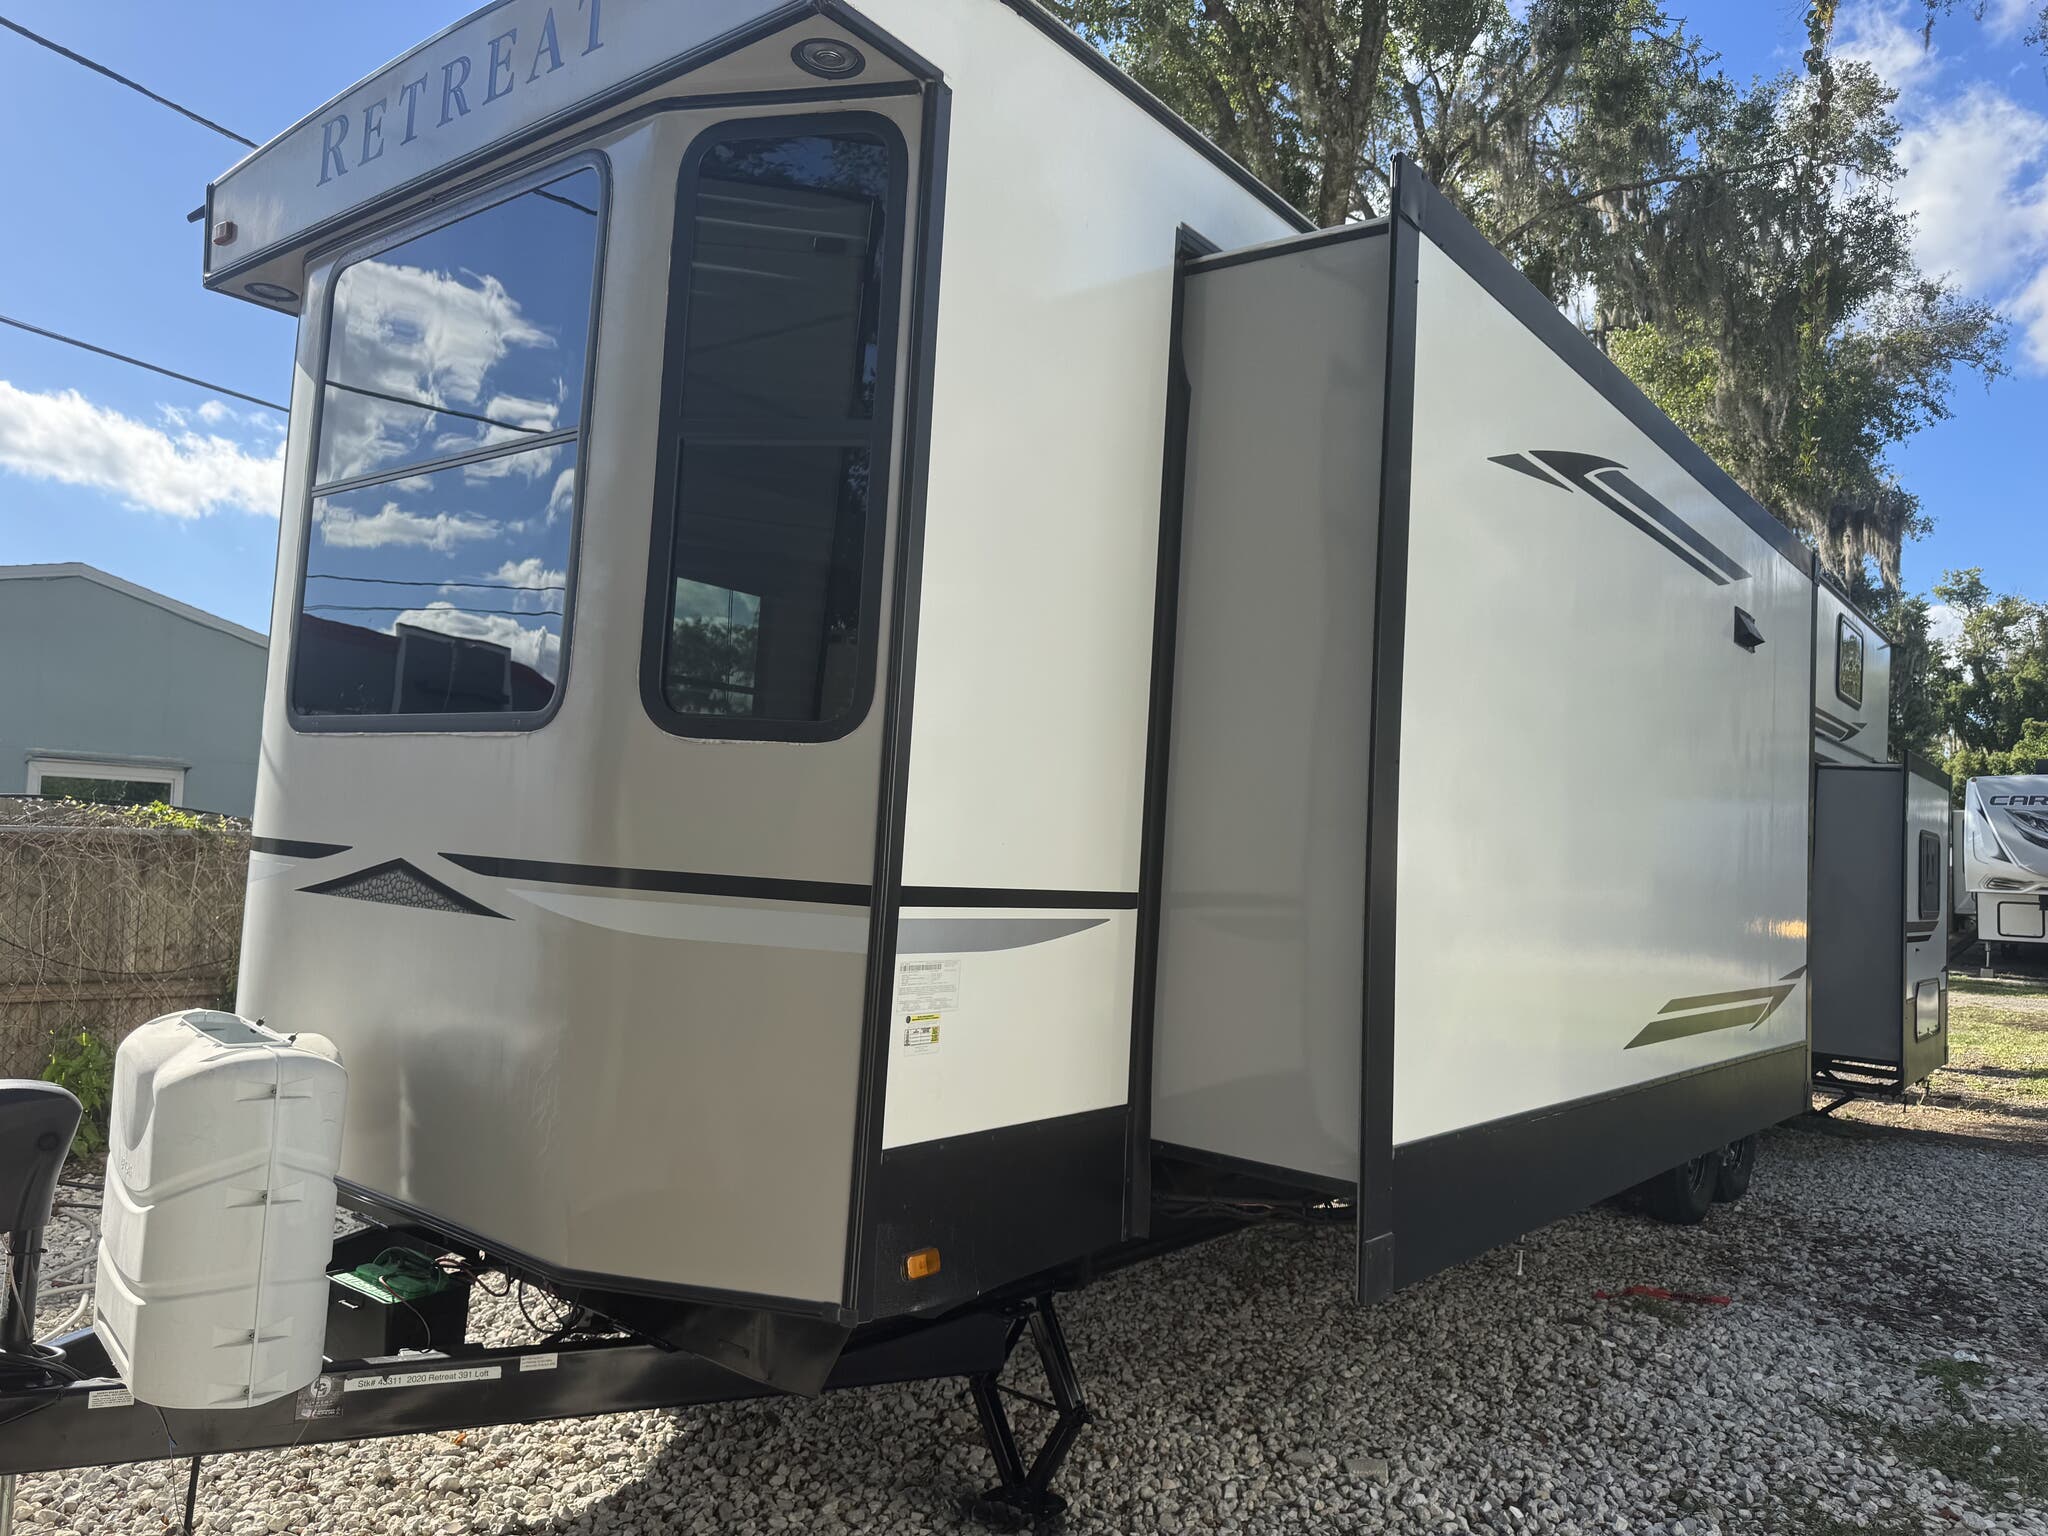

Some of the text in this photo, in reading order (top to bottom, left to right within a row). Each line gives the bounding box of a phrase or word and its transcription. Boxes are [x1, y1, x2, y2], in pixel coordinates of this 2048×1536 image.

[316, 0, 604, 188] RETREAT
[358, 1379, 376, 1388] Stk#
[406, 1375, 427, 1384] 2020
[428, 1372, 457, 1382] Retreat
[458, 1371, 472, 1379] 391
[474, 1370, 489, 1378] Loft
